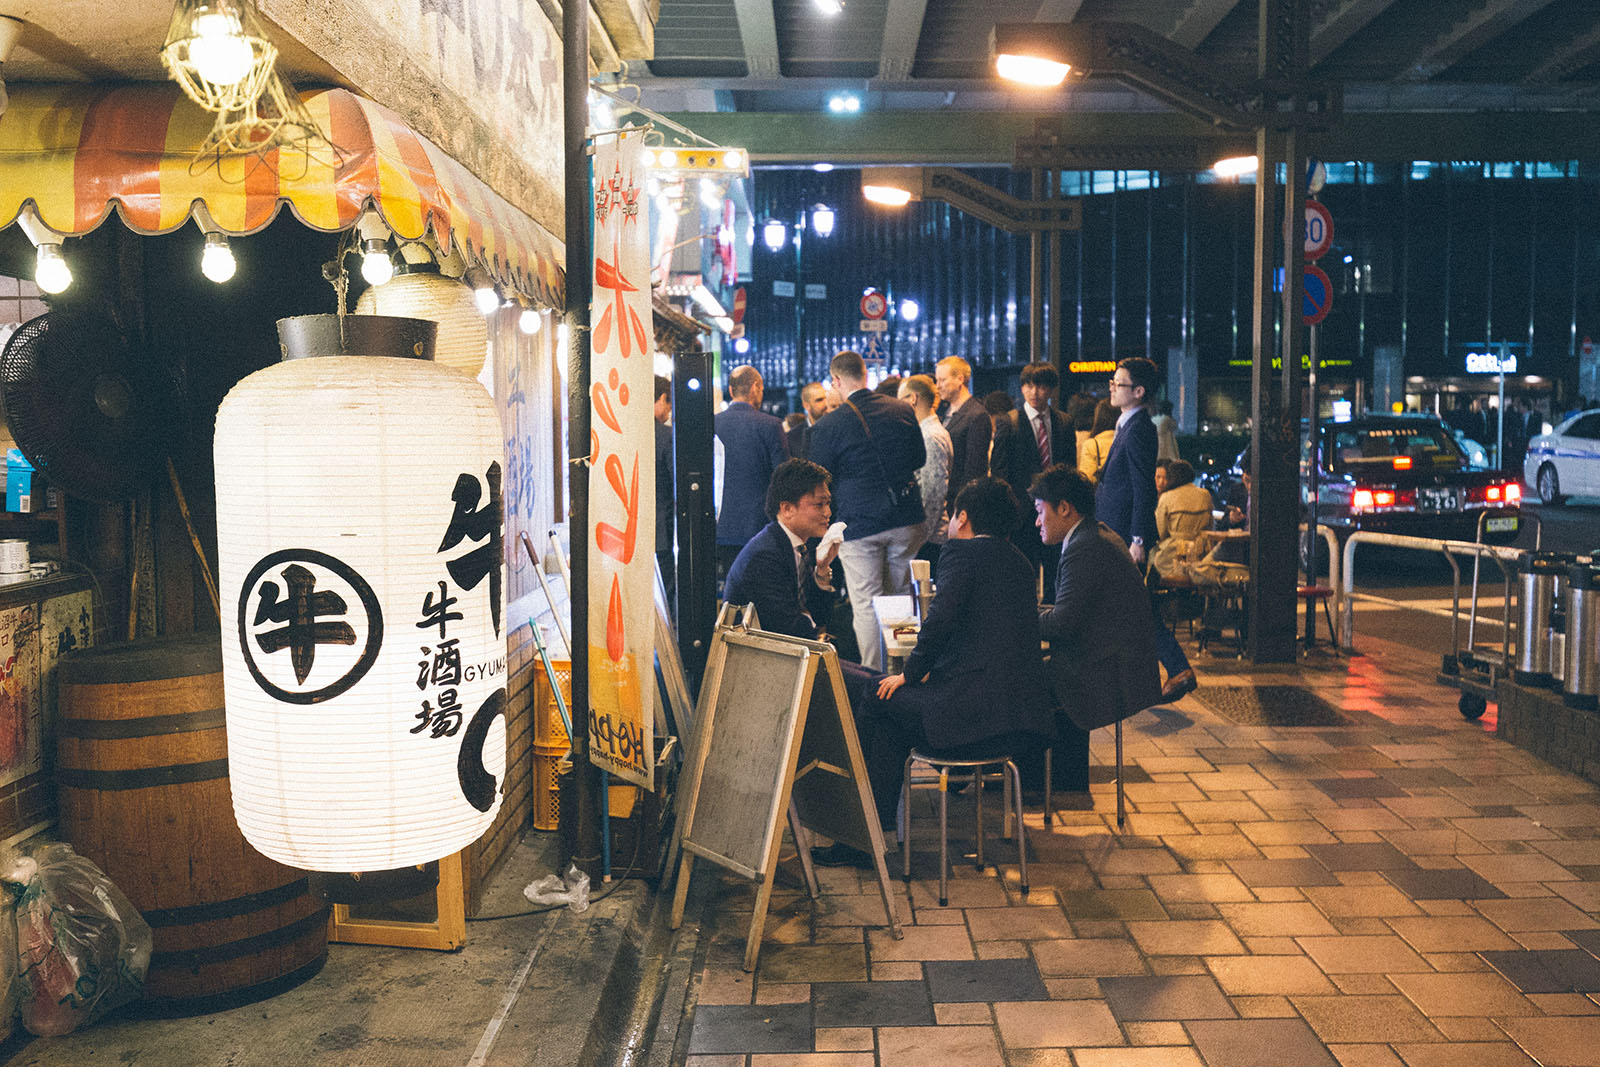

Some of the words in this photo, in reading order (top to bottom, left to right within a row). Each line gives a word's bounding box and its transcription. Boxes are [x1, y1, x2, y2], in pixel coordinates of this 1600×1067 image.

[253, 564, 358, 686] 牛
[410, 580, 464, 739] 牛酒場
